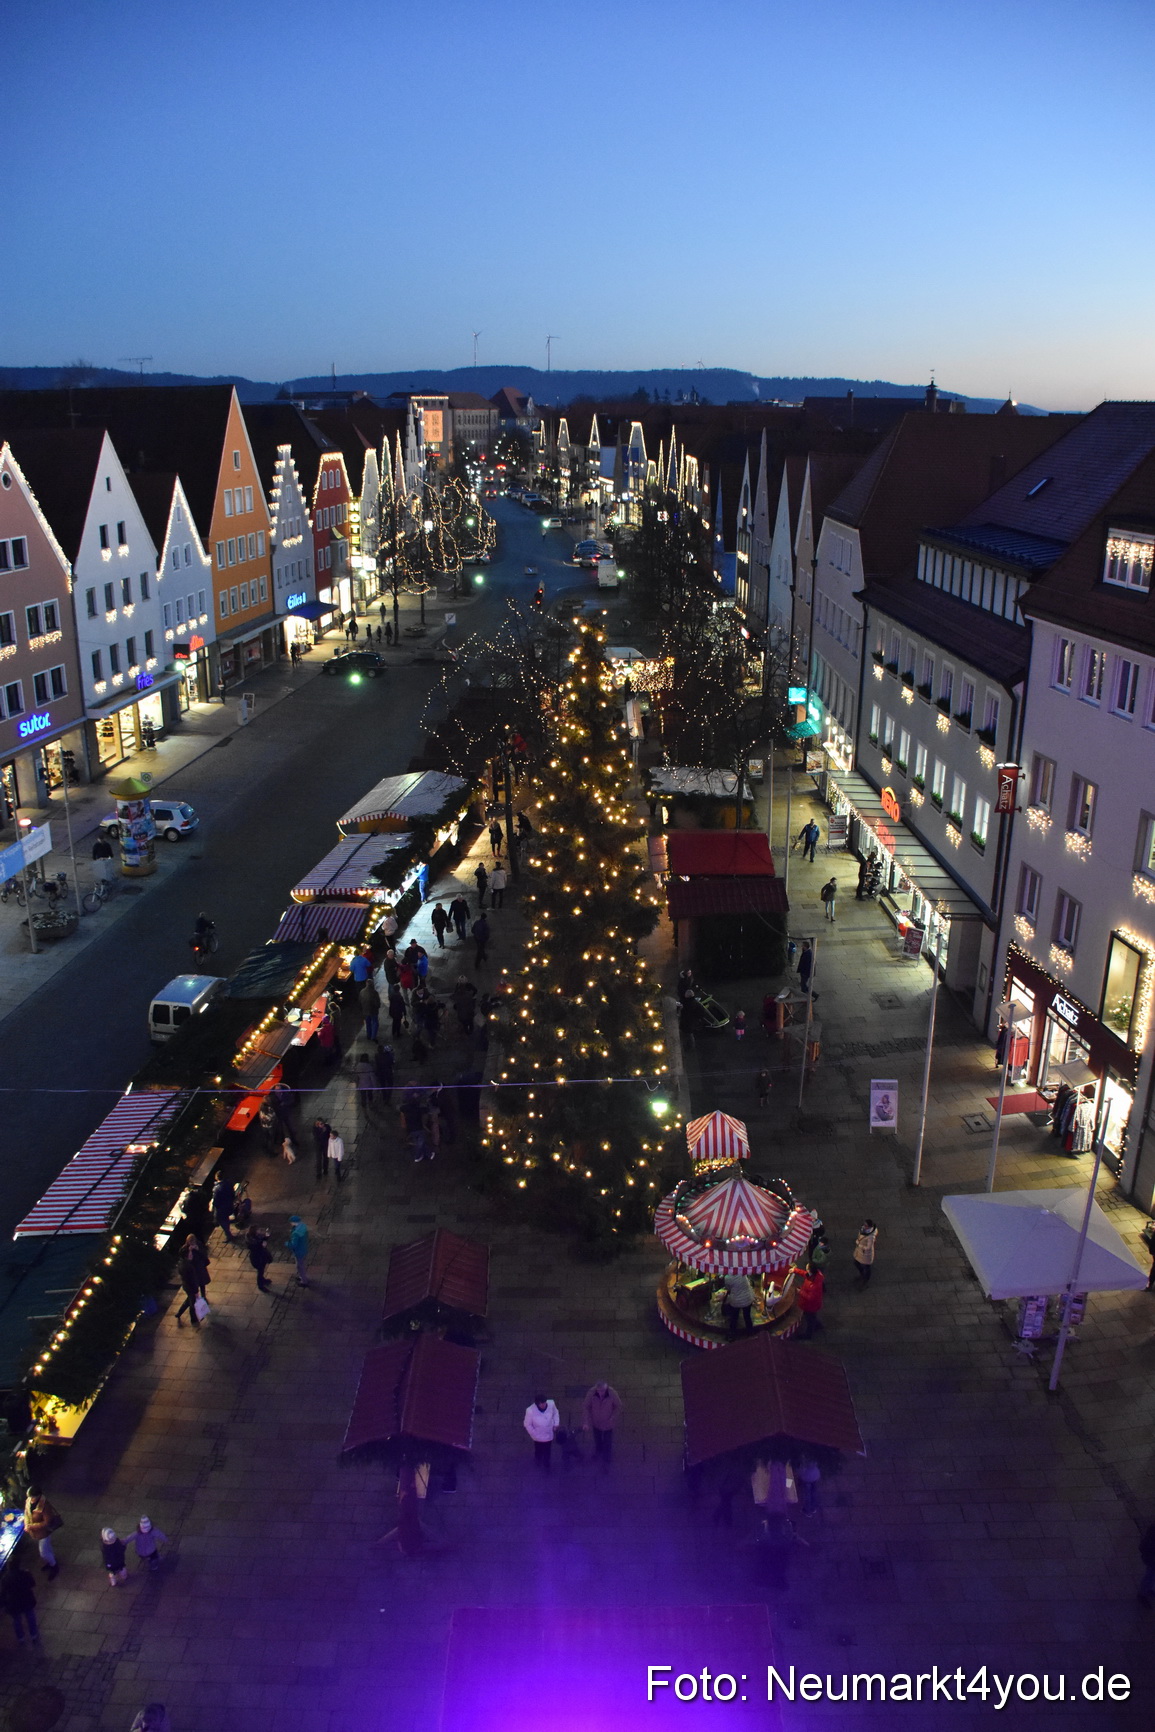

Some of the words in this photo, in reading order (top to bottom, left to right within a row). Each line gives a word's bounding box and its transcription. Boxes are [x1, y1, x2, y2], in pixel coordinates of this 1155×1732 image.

[350, 502, 361, 556] HOTEL
[136, 671, 154, 691] Fries
[1001, 774, 1014, 810] Achatz
[1051, 993, 1080, 1026] Achatz
